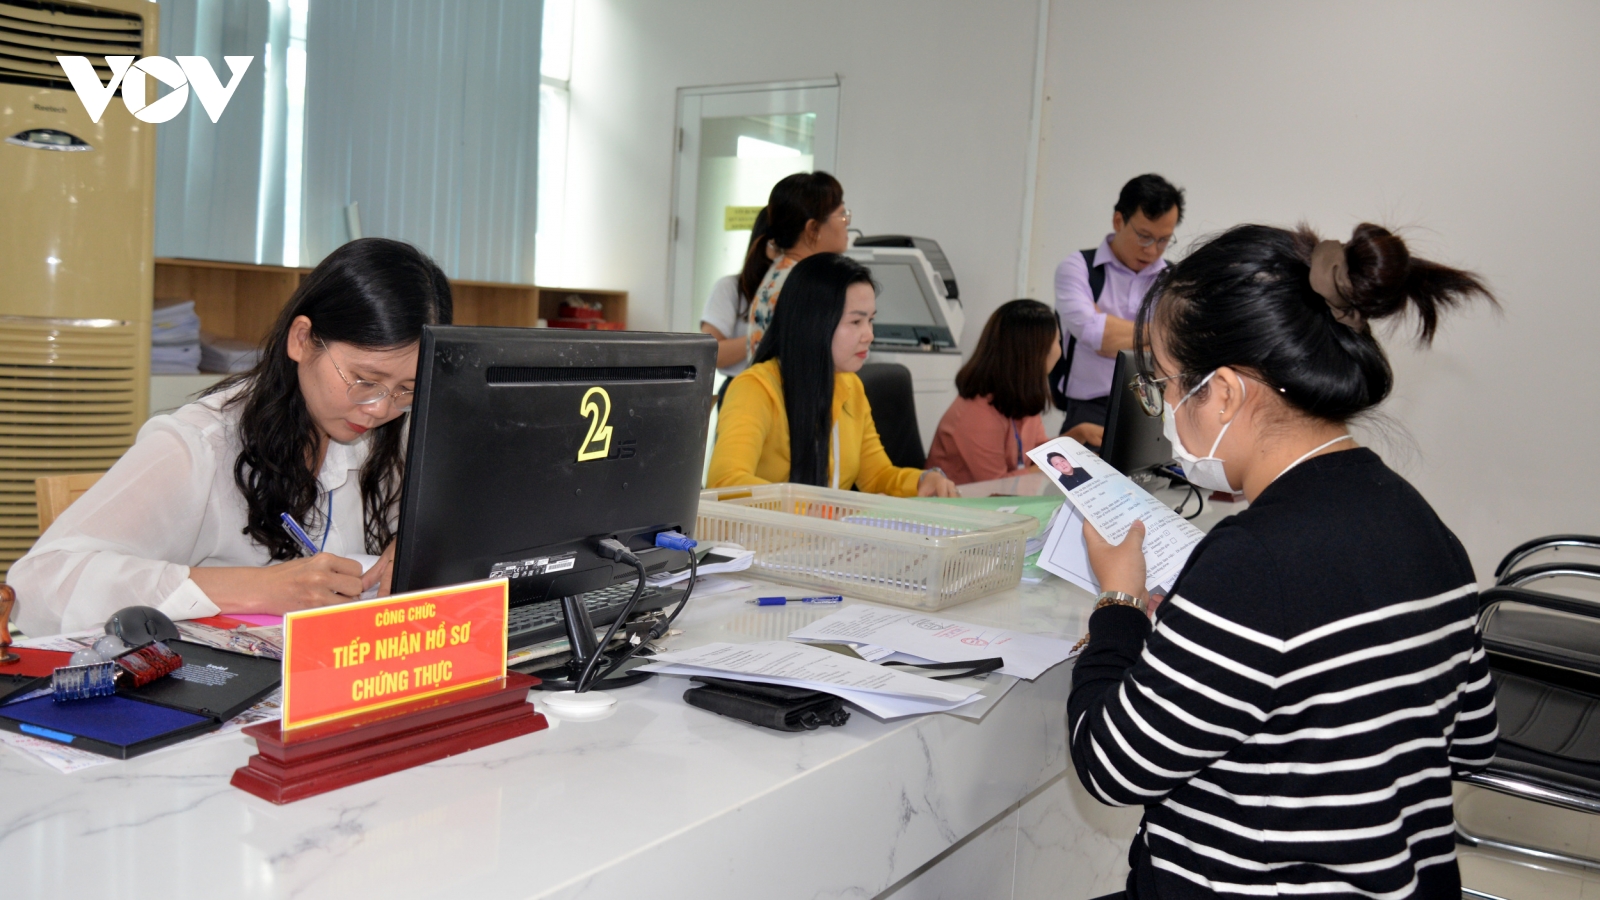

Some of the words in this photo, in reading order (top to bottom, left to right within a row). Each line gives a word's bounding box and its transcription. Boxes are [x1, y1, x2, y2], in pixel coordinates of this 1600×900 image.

[577, 386, 613, 462] 2
[375, 608, 405, 627] CÔNG
[407, 602, 436, 622] CHỨC
[333, 636, 371, 669] TIẾP
[375, 631, 421, 661] NHẬN
[425, 621, 446, 651] HỒ
[450, 621, 471, 646] SƠ
[351, 670, 409, 702] CHỨNG
[413, 660, 453, 688] THỰC
